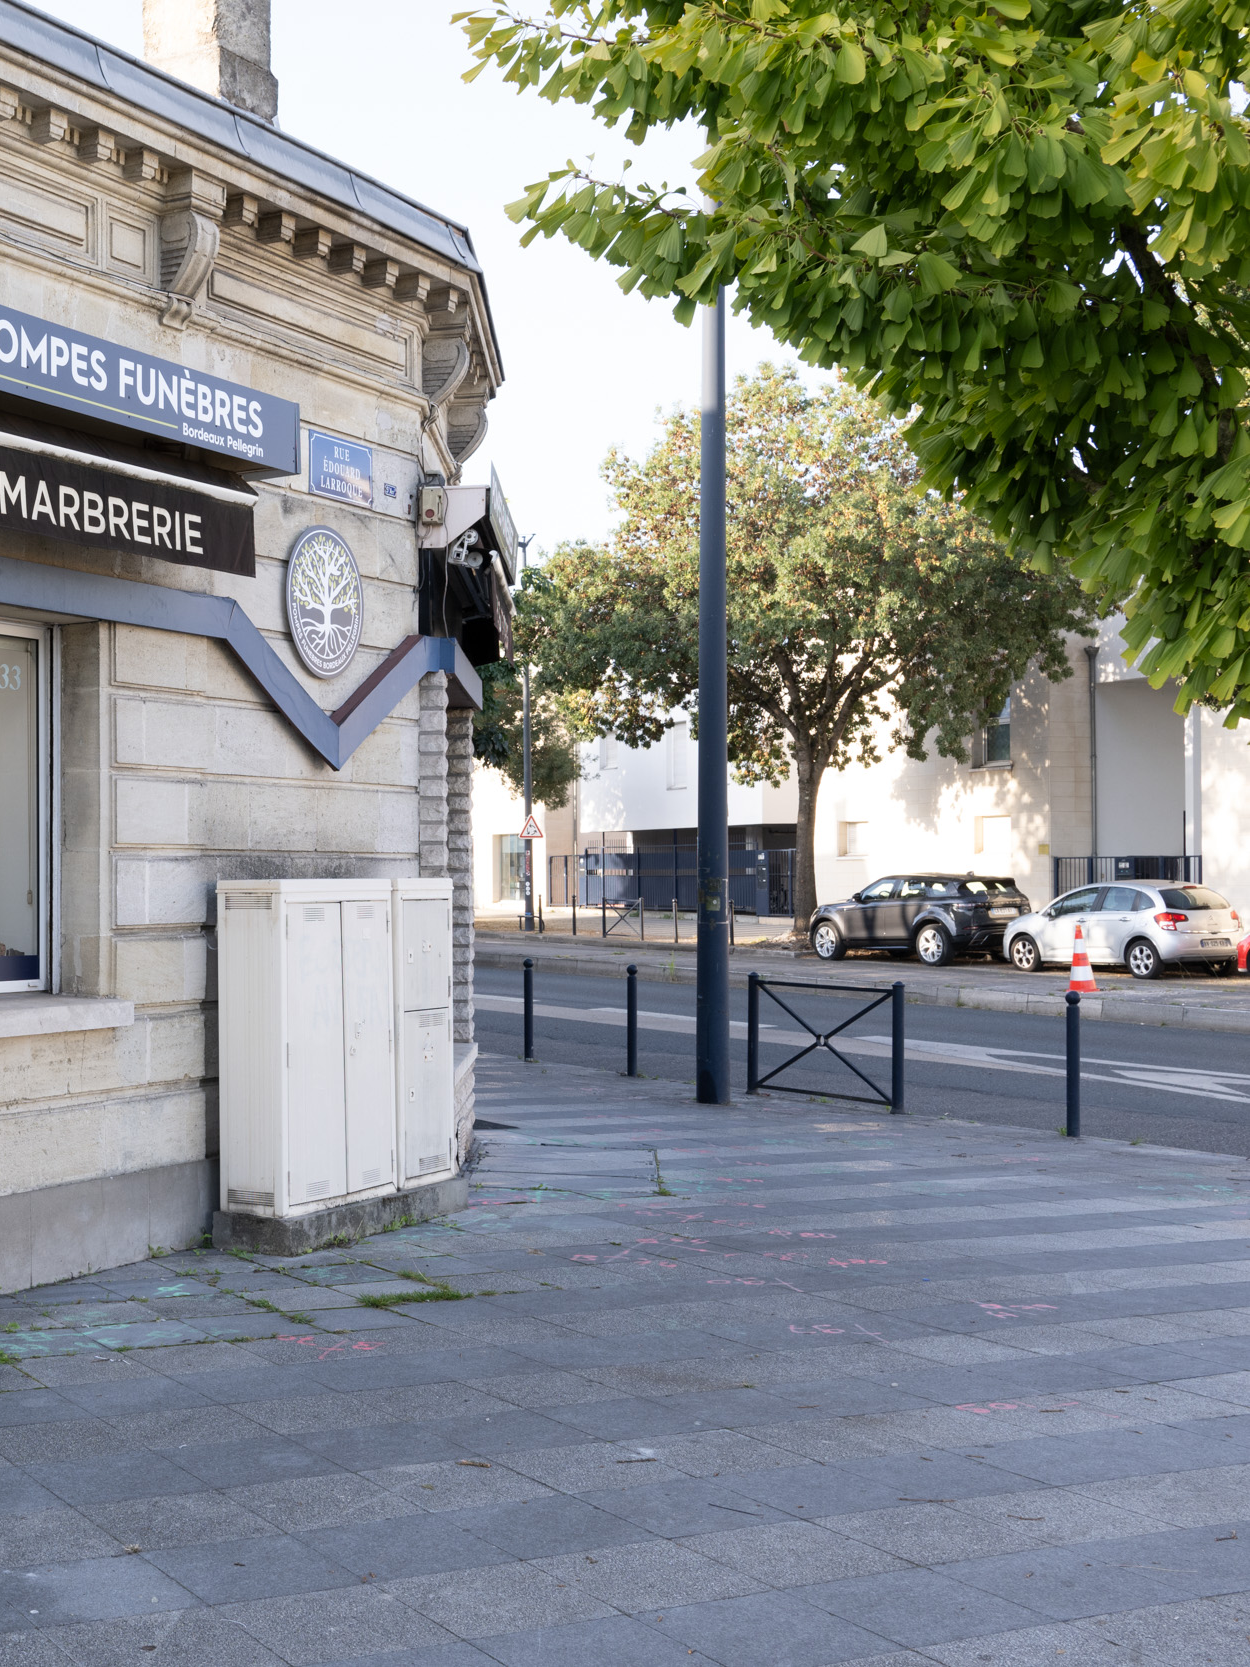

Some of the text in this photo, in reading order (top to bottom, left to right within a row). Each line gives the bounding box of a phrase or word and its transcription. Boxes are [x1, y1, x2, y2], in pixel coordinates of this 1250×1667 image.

[118, 368, 264, 438] FUNÈBRES
[182, 422, 264, 458] Bordeaux Pellegrin
[333, 446, 350, 462] RUE
[323, 456, 361, 481] ÉDOUARD
[320, 475, 363, 498] LARROQUE
[291, 602, 304, 639] POMPES
[322, 652, 348, 670] BORDEAUX
[345, 614, 360, 656] PELLEGRIN
